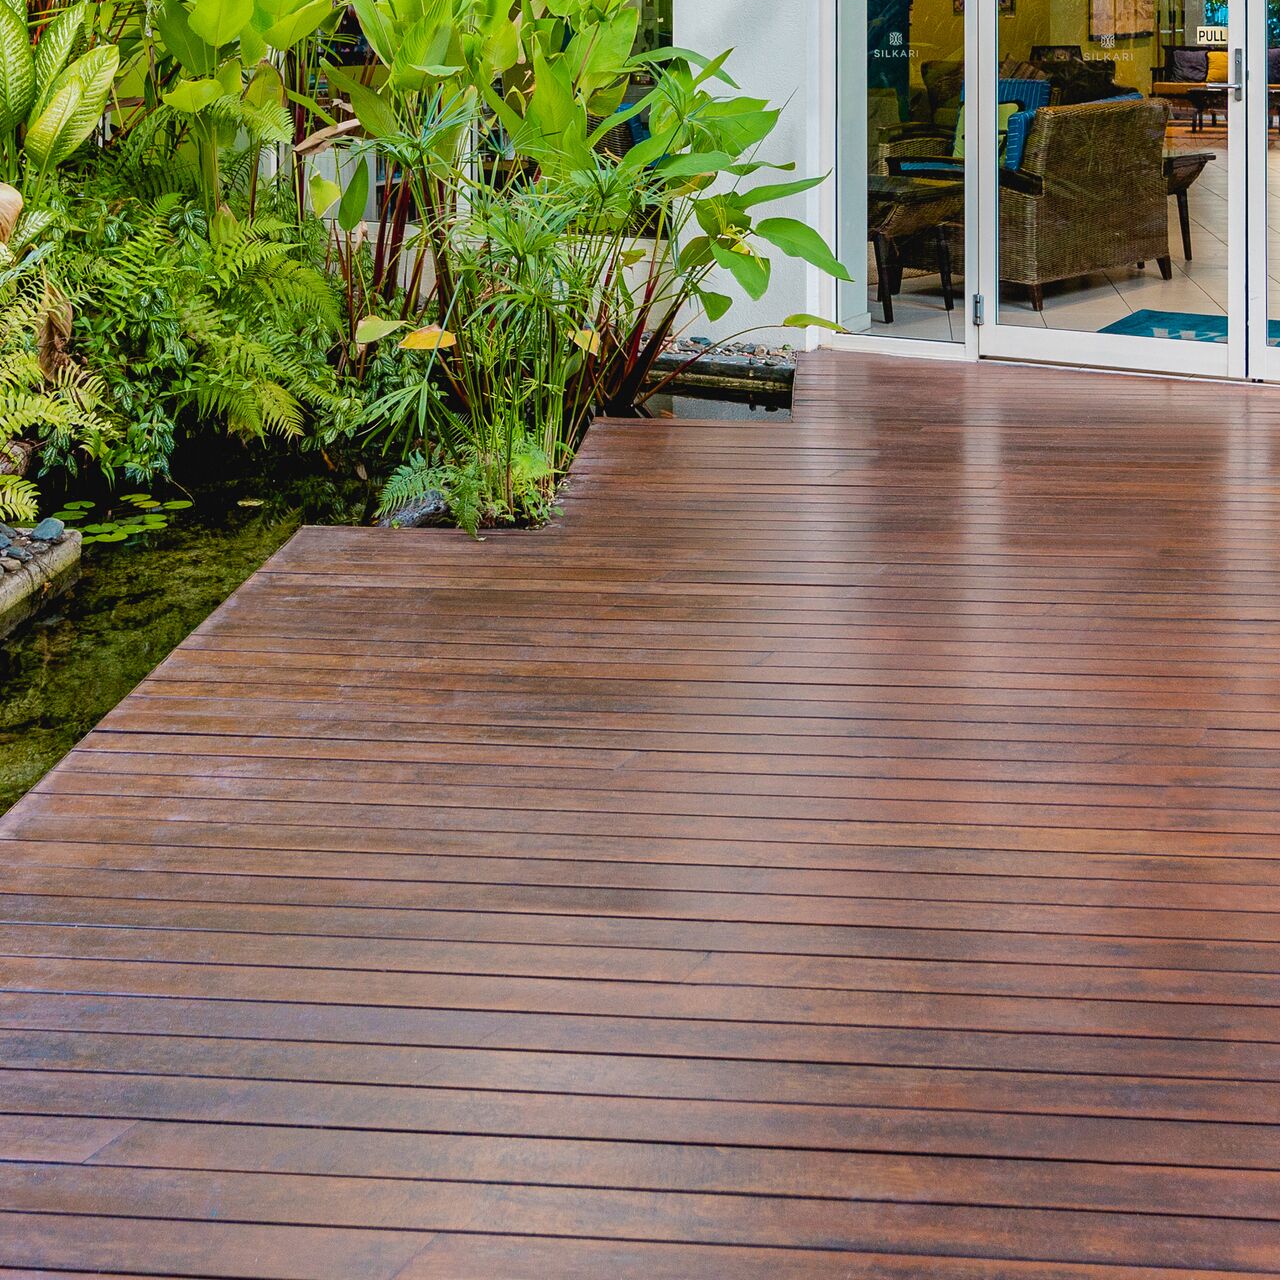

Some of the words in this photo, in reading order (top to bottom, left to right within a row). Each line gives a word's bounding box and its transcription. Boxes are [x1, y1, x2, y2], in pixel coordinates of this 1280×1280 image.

[1198, 30, 1227, 42] PULL
[873, 48, 919, 58] SILKARI
[1082, 52, 1134, 62] SILKARI
